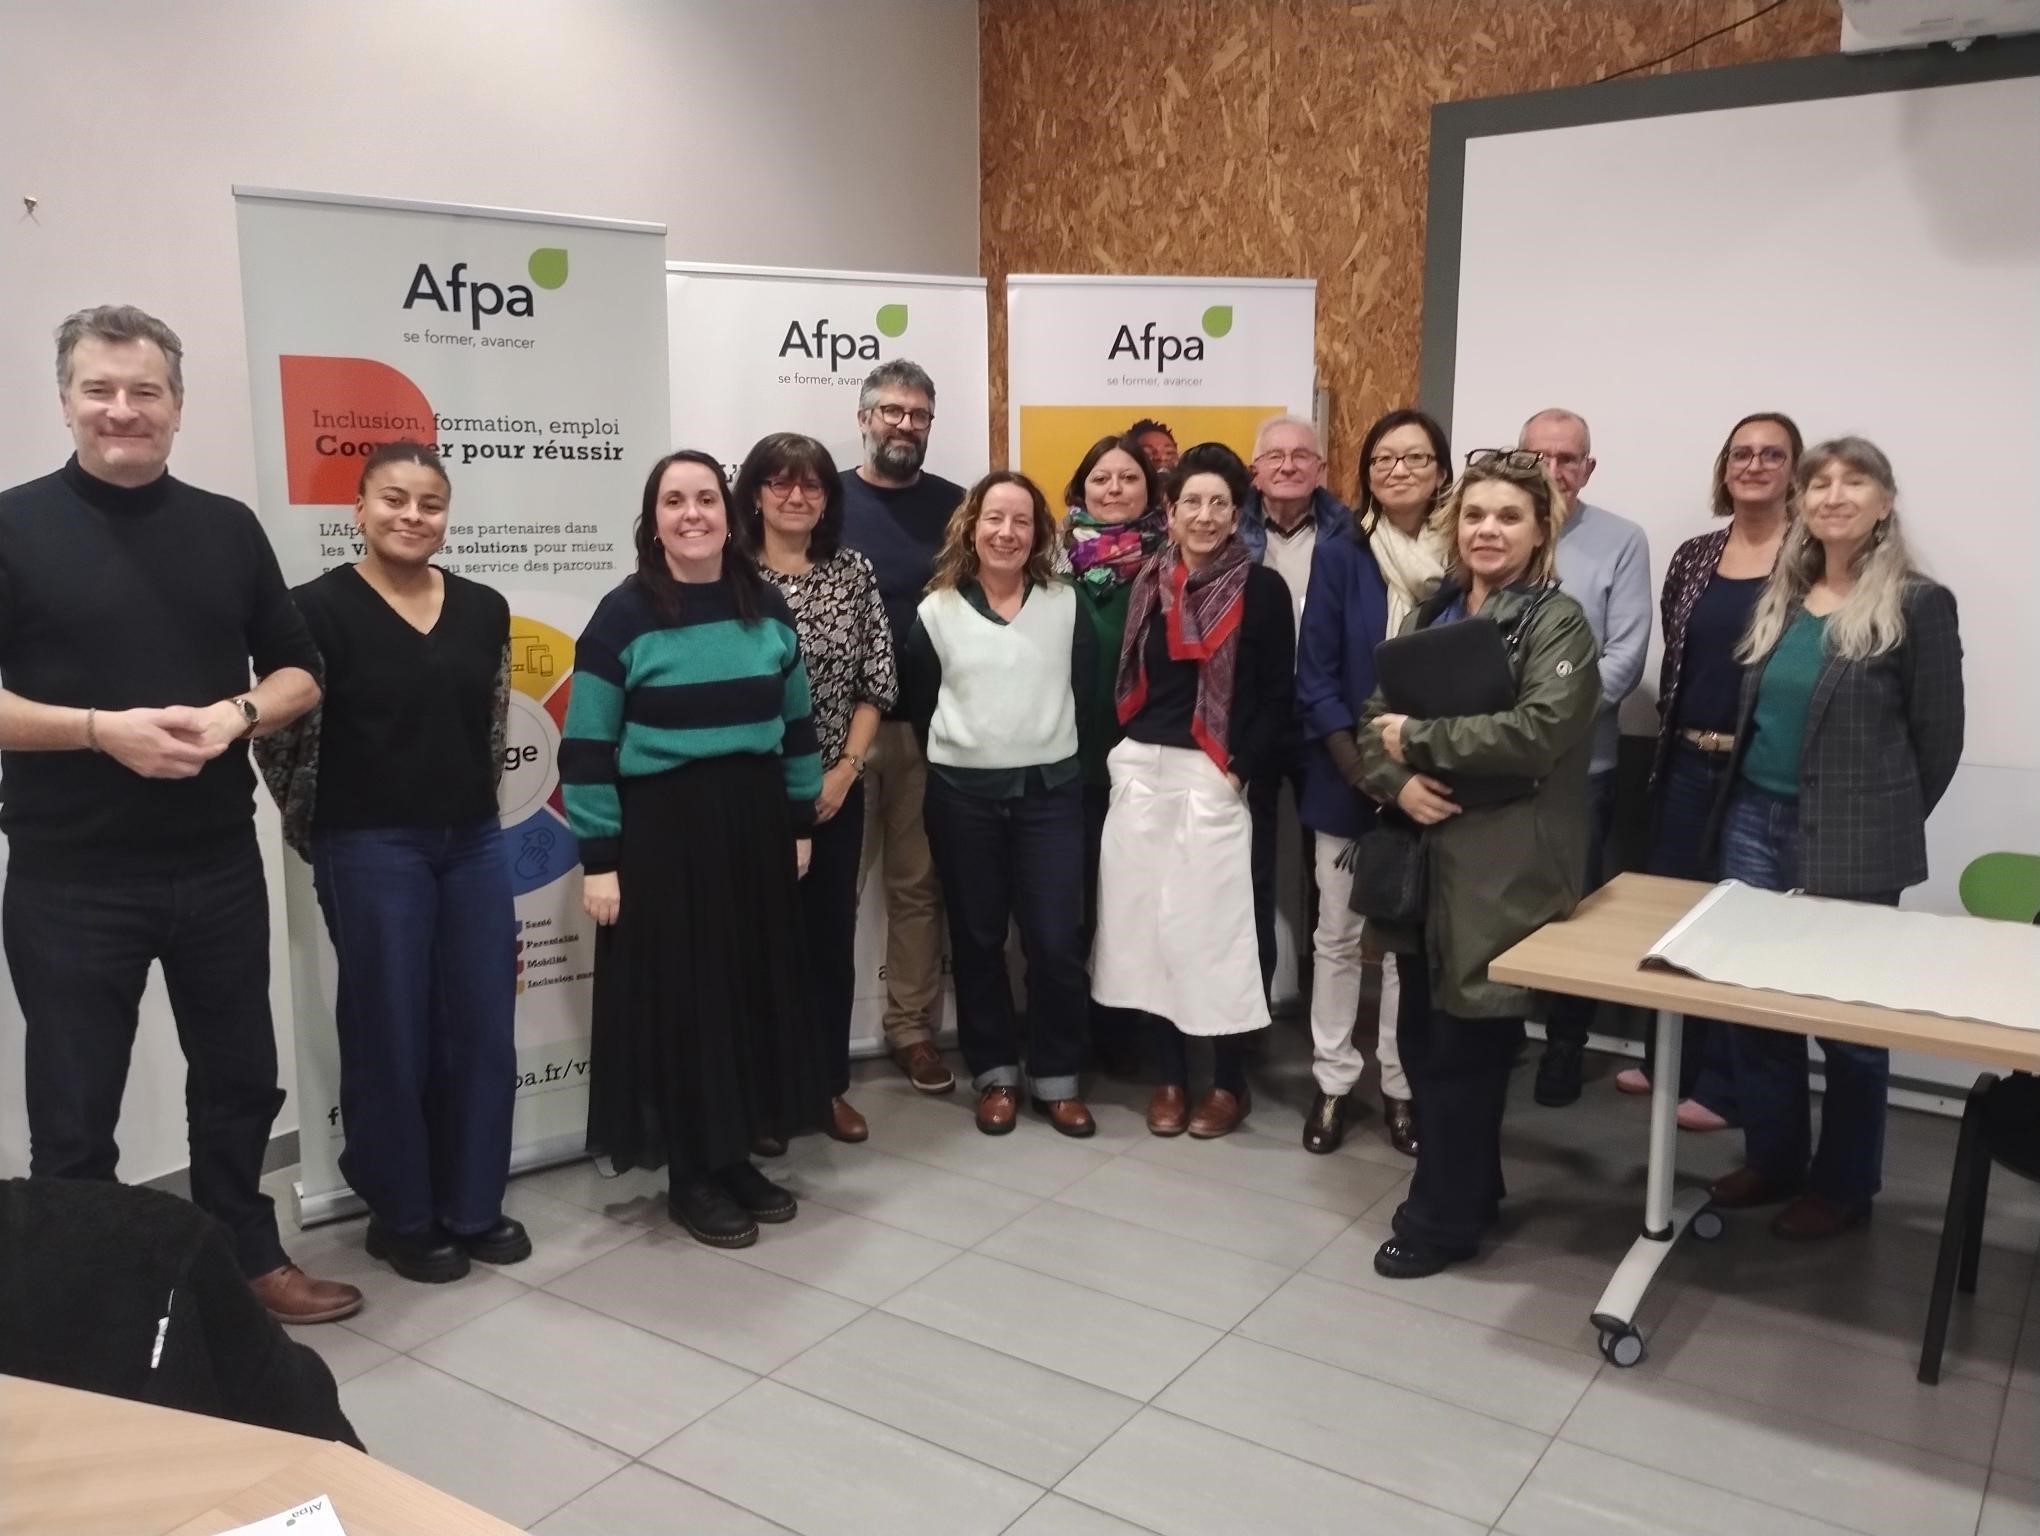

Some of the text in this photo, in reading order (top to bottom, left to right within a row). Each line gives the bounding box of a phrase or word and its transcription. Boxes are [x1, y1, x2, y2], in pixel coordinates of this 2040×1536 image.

[403, 263, 534, 331] Afpa
[403, 329, 536, 349] se former, avancer
[779, 318, 880, 372] Afpa
[1108, 322, 1204, 373] Afpa
[778, 372, 865, 386] se former, avan
[1107, 375, 1203, 387] se former, avancer
[312, 409, 620, 438] Inclusion, formation, emploi
[462, 442, 526, 464] pour
[533, 439, 624, 461] réussir
[320, 522, 598, 539] L'Afp ses partenaires dans
[321, 544, 345, 556] les
[457, 541, 528, 554] solutions
[534, 543, 568, 556] pour
[571, 541, 614, 553] mieux
[465, 561, 519, 573] service
[523, 560, 549, 572] des
